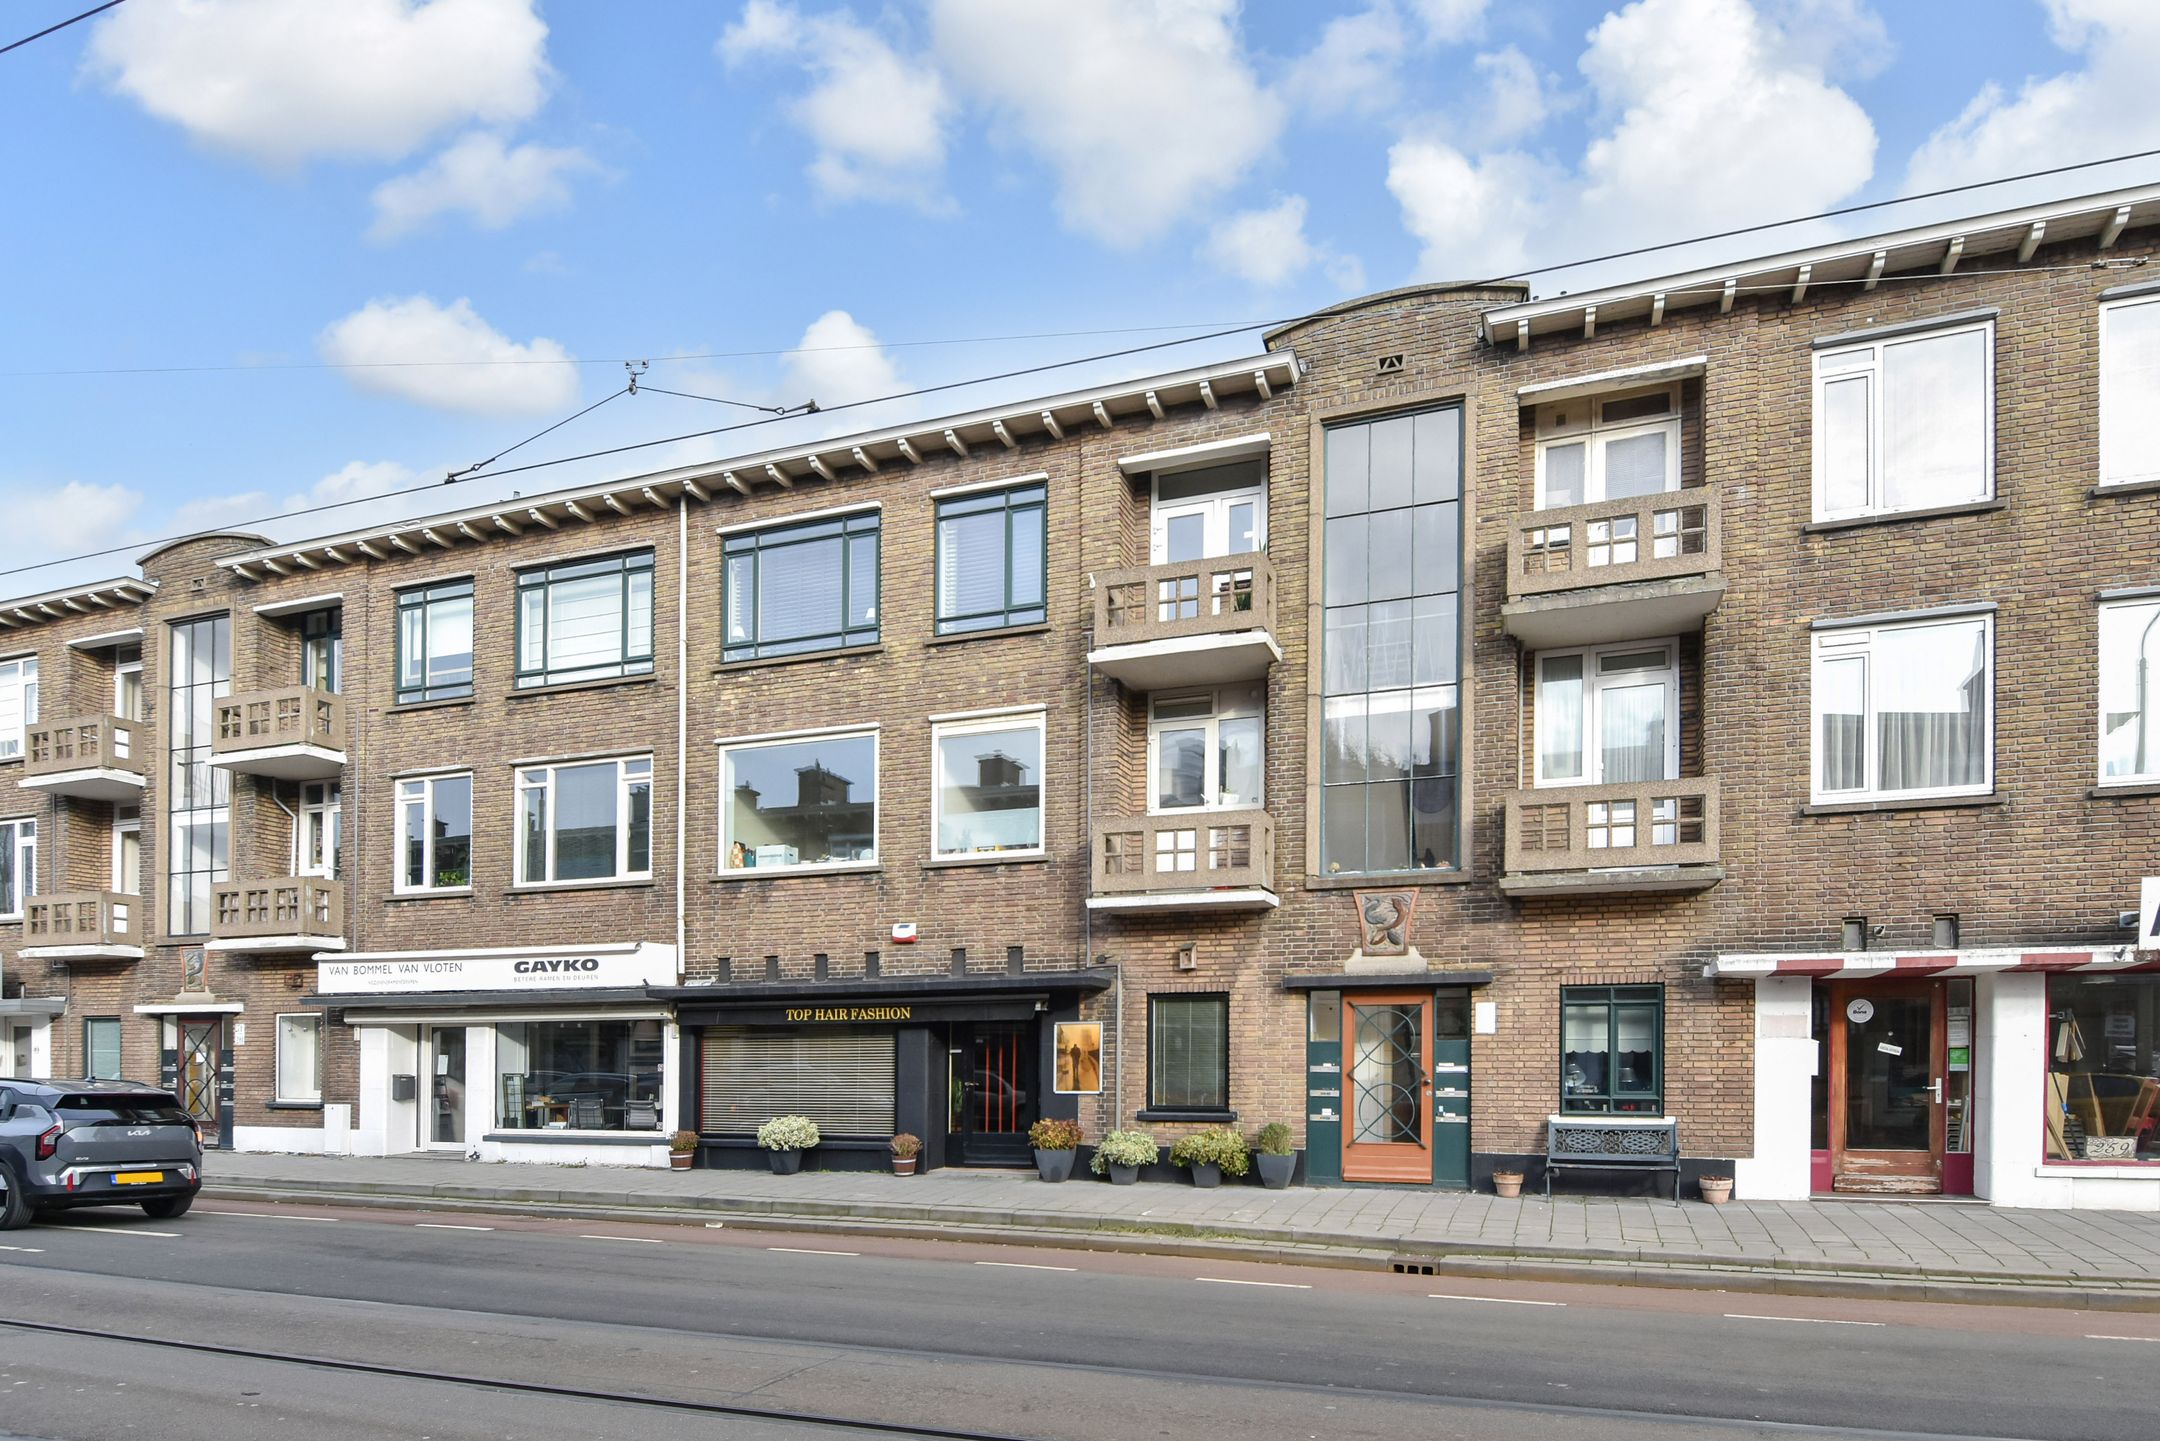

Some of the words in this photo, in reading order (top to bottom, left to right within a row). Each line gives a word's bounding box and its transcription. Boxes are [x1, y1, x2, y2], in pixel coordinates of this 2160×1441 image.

[329, 966, 349, 975] VAN
[353, 964, 393, 975] BOMMEL
[398, 963, 419, 973] VAN
[423, 962, 463, 973] VLOTEN
[514, 958, 599, 973] GAYKO
[786, 1009, 812, 1021] TOP
[815, 1008, 847, 1020] HAIR
[850, 1007, 911, 1020] FASHION
[2090, 1142, 2130, 1156] 259
